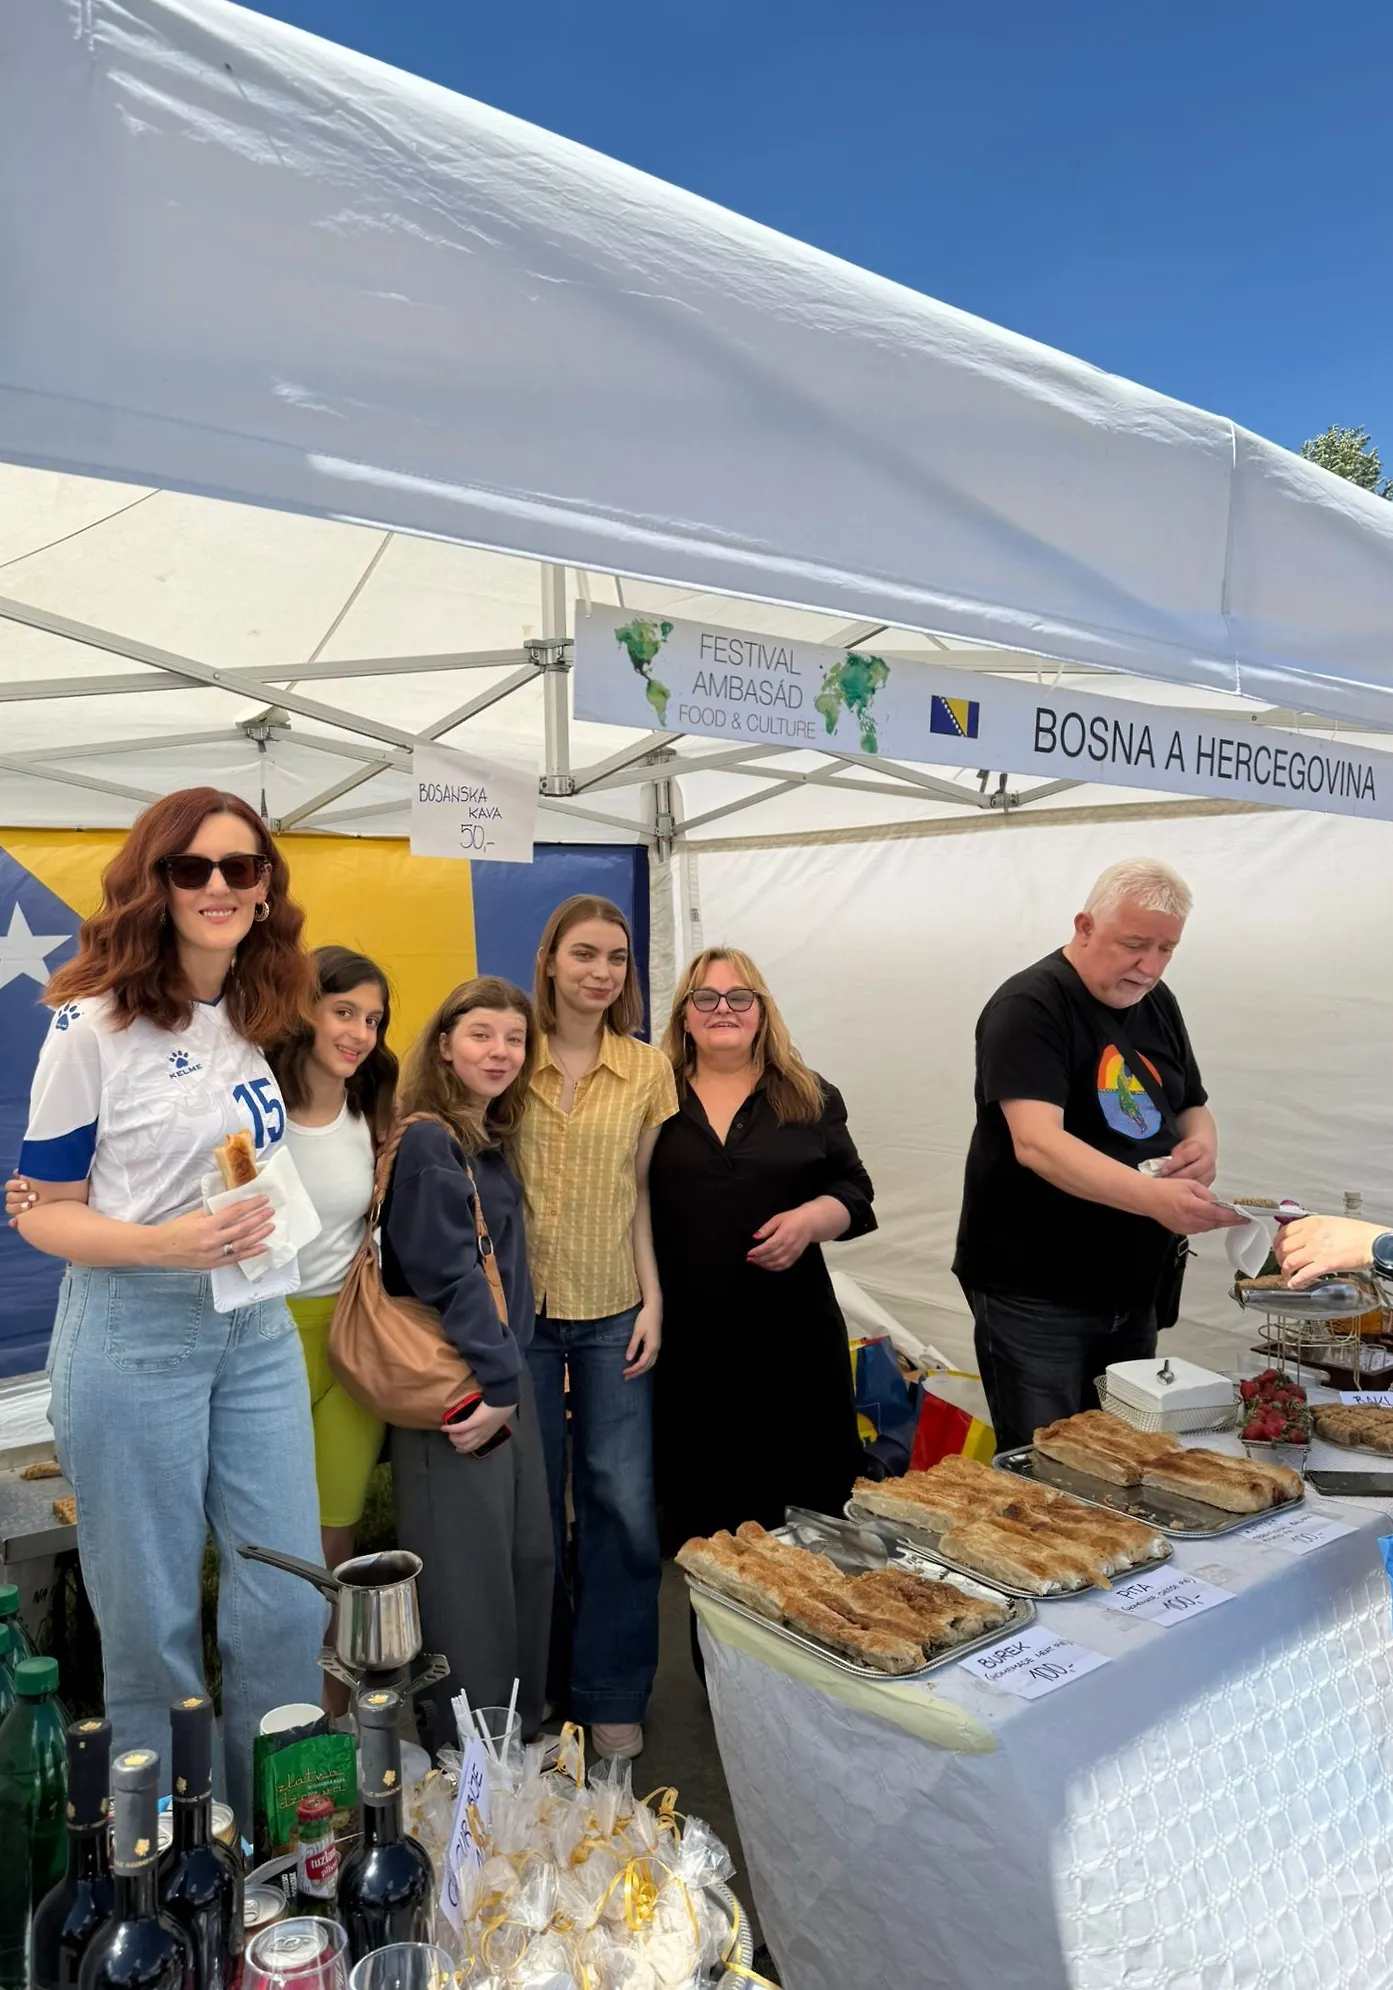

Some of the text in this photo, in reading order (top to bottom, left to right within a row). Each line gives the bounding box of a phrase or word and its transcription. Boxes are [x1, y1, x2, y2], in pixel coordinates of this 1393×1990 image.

[700, 633, 802, 676] FESTIVAL
[692, 671, 803, 709] AMBASÁD
[679, 704, 817, 739] FOOD & CULTURE
[1034, 707, 1376, 801] BOSNA A HERCEGOVINA
[419, 783, 488, 804] BOSANSKA
[468, 806, 503, 820] KAVA
[169, 1063, 203, 1079] KELME
[232, 1077, 285, 1149] 15
[977, 1641, 1031, 1669] BUREK
